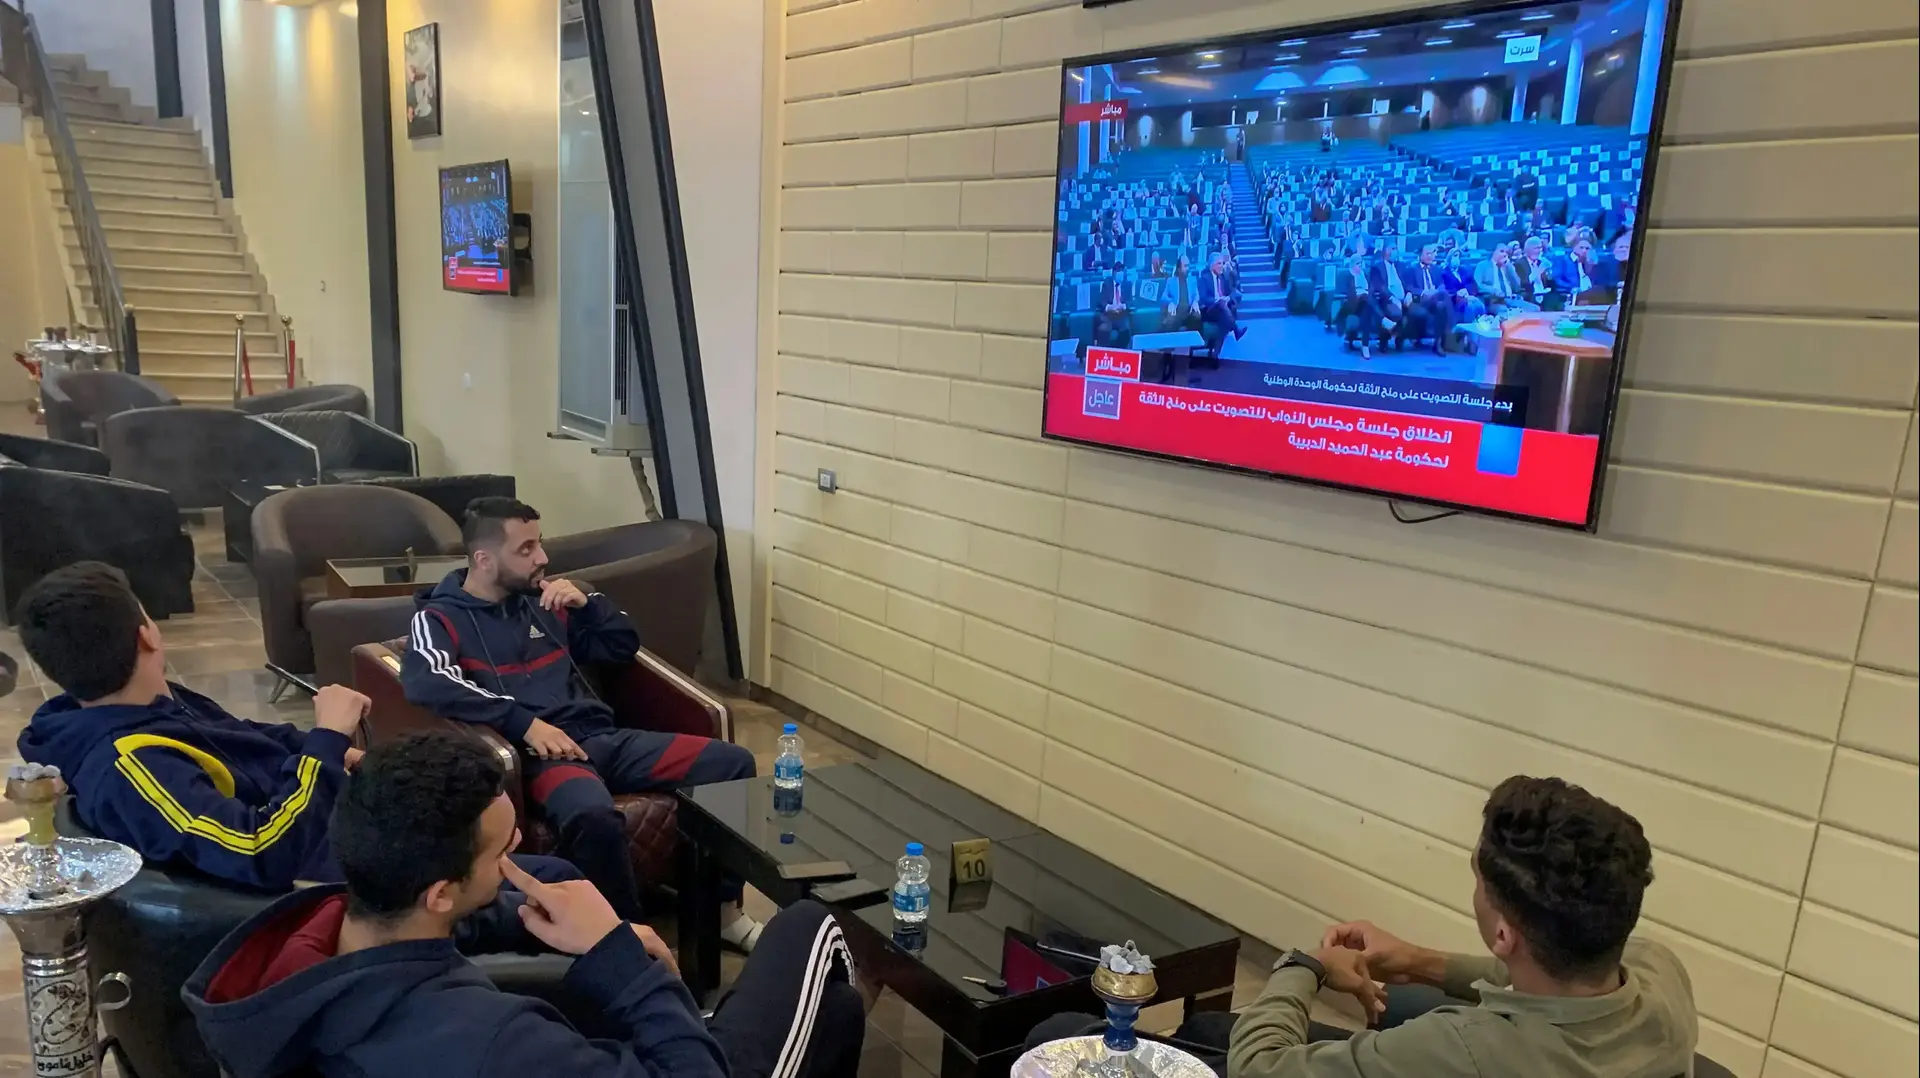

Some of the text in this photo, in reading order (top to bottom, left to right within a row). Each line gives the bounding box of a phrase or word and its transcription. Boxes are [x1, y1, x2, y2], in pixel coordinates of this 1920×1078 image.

[1510, 45, 1535, 57] سرت
[1100, 102, 1122, 117] مباشر
[1093, 353, 1131, 375] مباشر
[1088, 388, 1114, 408] عاجل
[1263, 373, 1513, 413] بدء جلسة التصويت على منح الثقة لحكومة الوحدة الوطنية
[1138, 390, 1452, 444] انطلاق جلسة مجلس النواب للتصويت على منح الثقة
[1288, 431, 1449, 469] لحكومة عبد الحميد الدبيبة
[962, 858, 986, 879] 10
